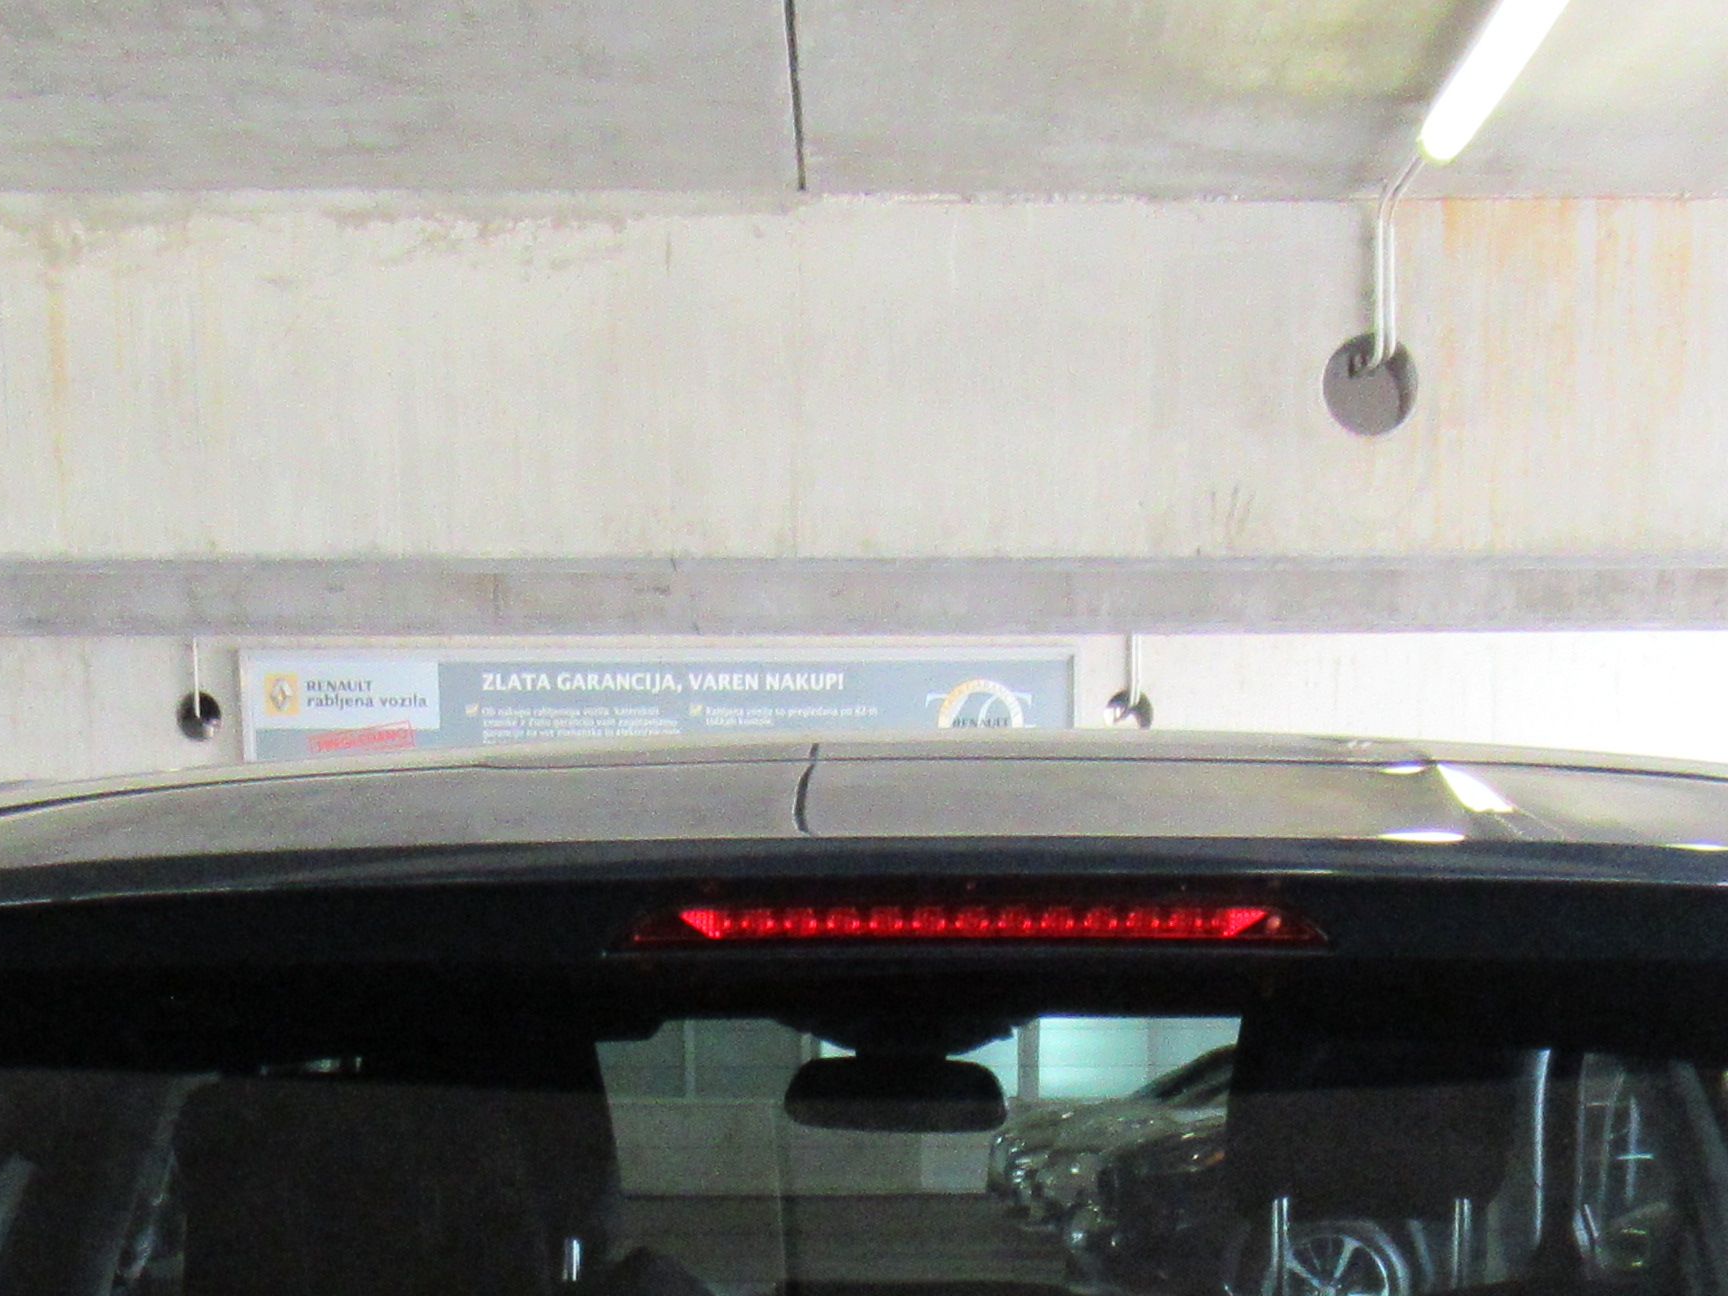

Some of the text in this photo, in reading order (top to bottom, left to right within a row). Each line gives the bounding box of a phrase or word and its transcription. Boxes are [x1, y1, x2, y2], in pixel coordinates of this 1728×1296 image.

[306, 680, 373, 691] RENAULT
[482, 673, 844, 694] ZLATA GARANCIJA, VAREN NAKUP!
[306, 694, 428, 711] rabljena vozila
